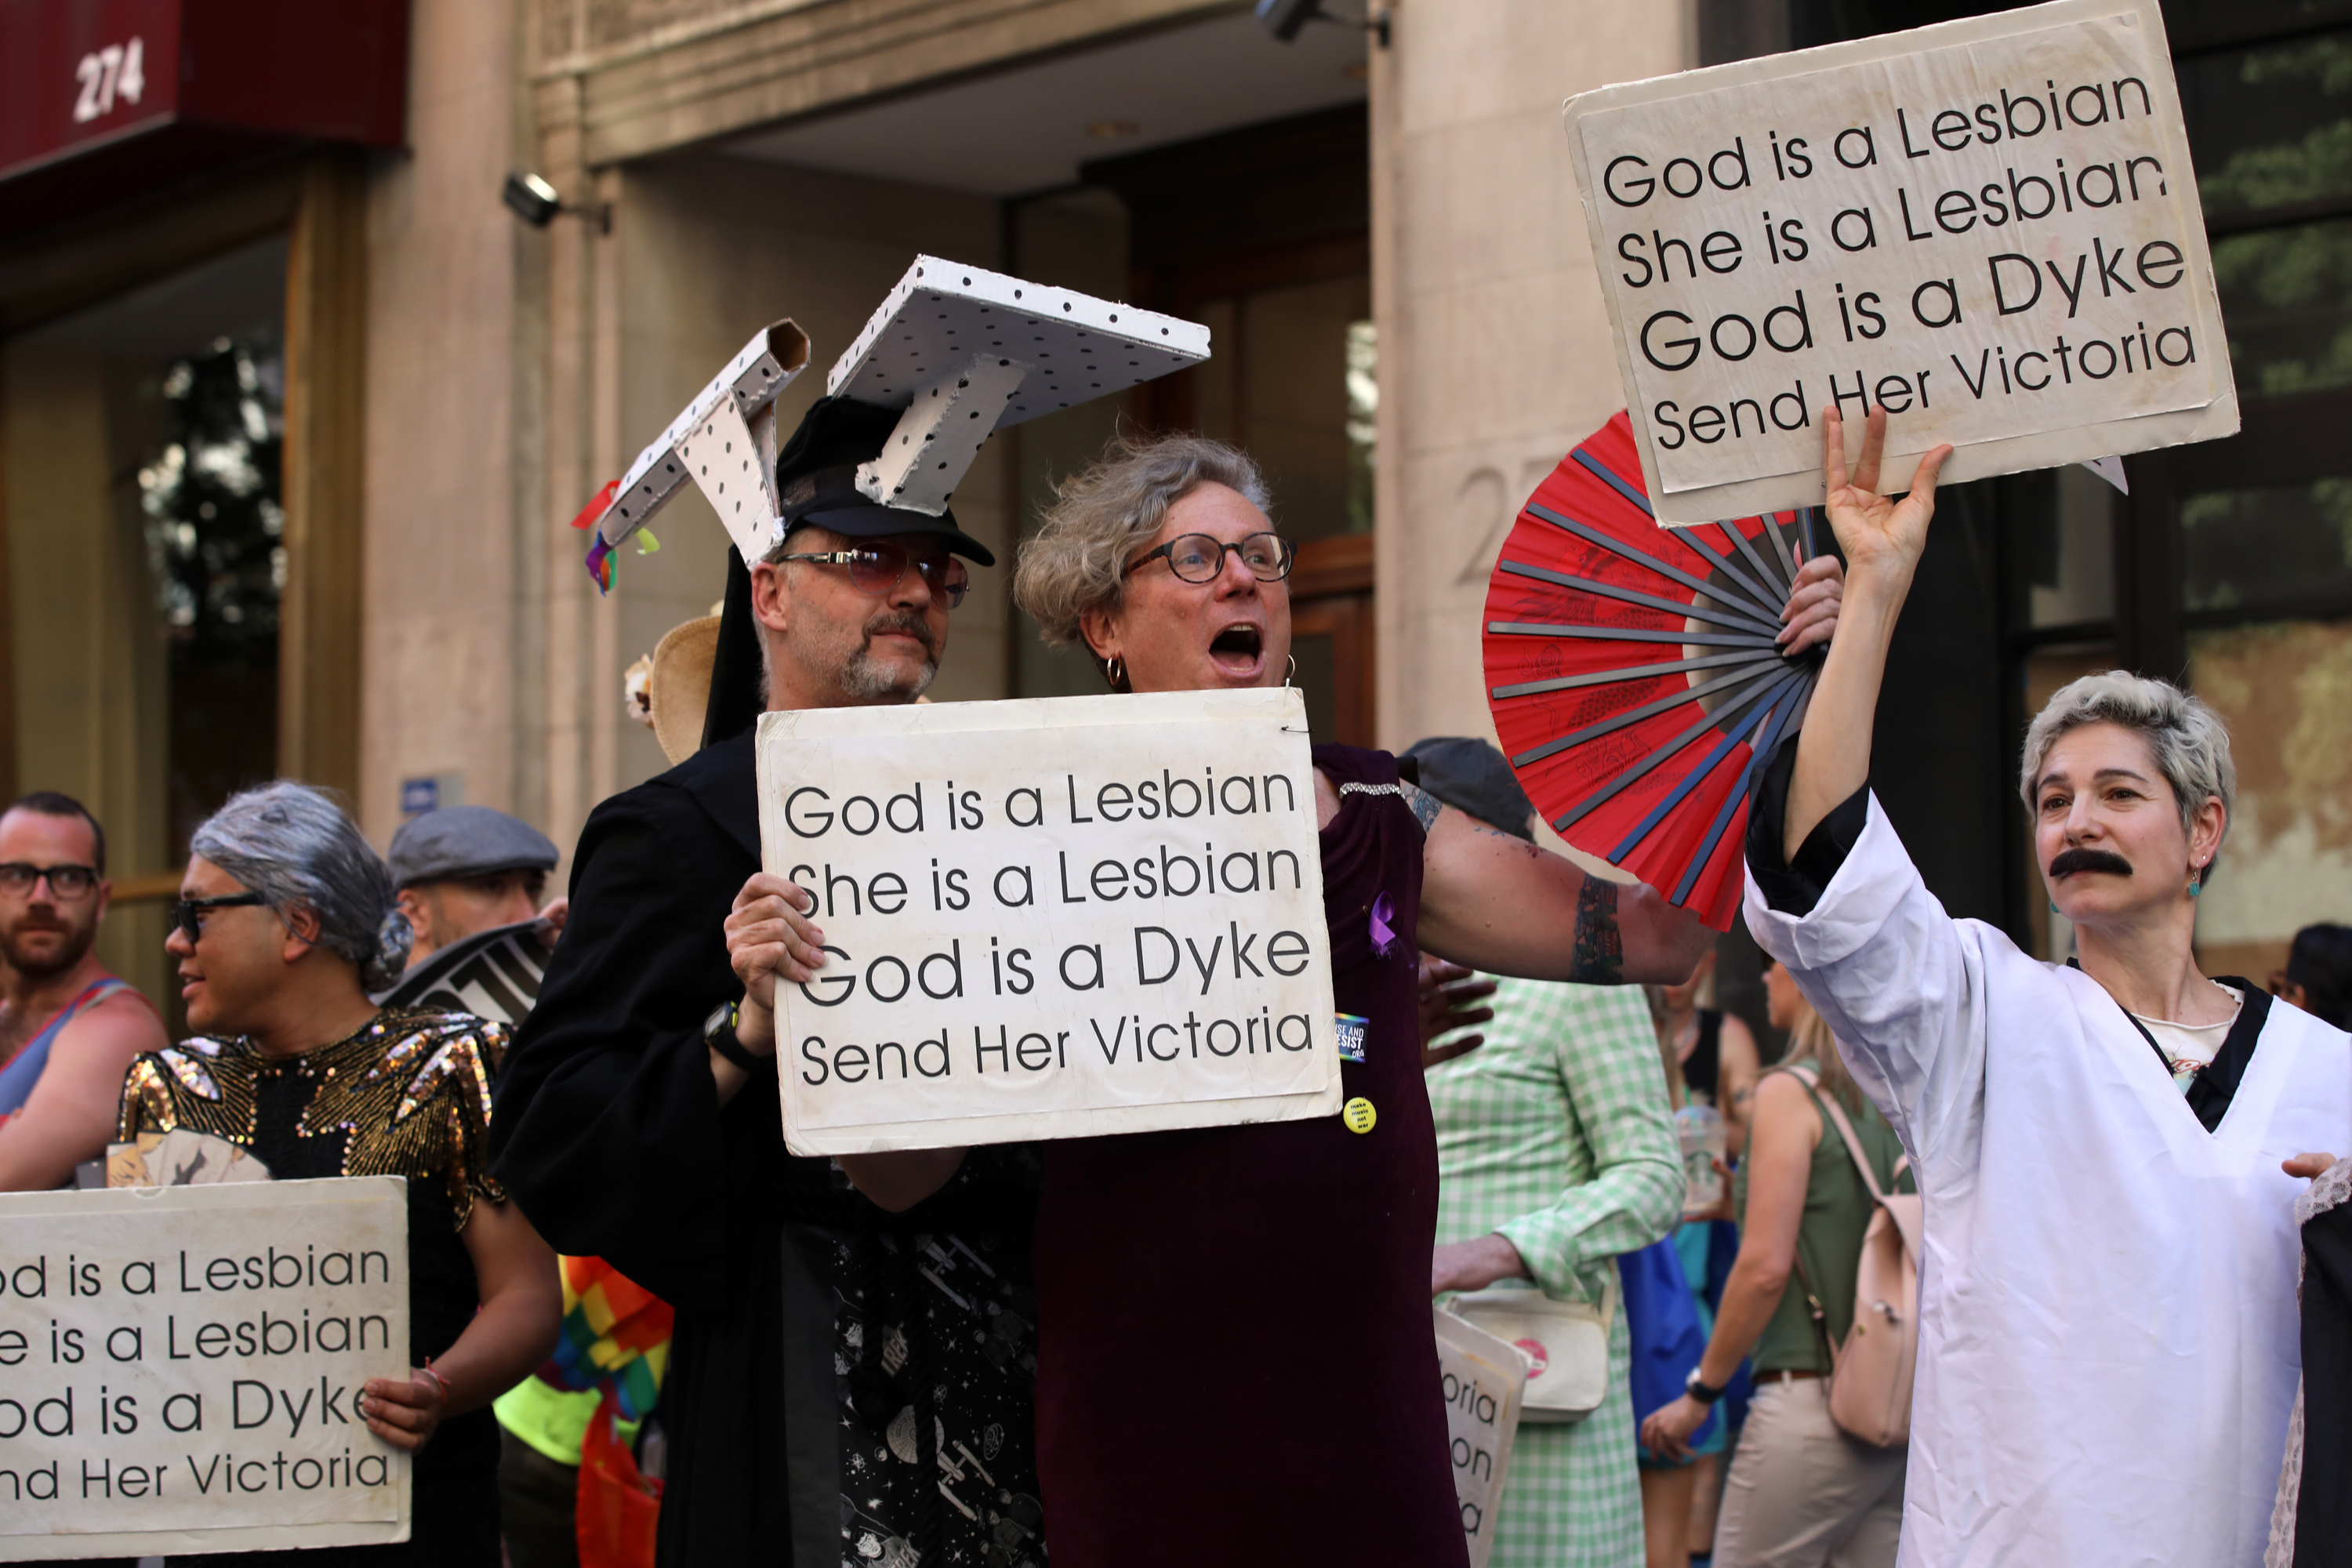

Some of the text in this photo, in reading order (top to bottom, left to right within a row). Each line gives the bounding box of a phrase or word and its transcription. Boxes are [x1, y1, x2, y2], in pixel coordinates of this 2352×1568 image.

[72, 35, 145, 124] 274
[1603, 76, 2152, 208] God is a Lesbian
[1617, 154, 2167, 289] She is a Lesbian
[1639, 237, 2185, 372] God is a Dyke
[1654, 321, 2197, 450] Send Her Victoria
[785, 766, 1295, 839] God is a Lesbian
[788, 841, 1301, 920] She is a Lesbian
[799, 920, 1310, 1007] God is a Dyke
[801, 1006, 1313, 1086] Send Her Victoria
[1348, 1025, 1364, 1039] AND
[70, 1254, 101, 1297] is
[122, 1261, 157, 1295] a
[180, 1243, 390, 1294] Lesbian
[51, 1319, 85, 1364] is
[106, 1326, 143, 1363] a
[169, 1308, 389, 1359] Lesbian
[101, 1385, 138, 1435] is
[162, 1392, 202, 1432] a
[1440, 1360, 1497, 1426] oria
[82, 1457, 168, 1499] Her
[187, 1447, 389, 1495] Victoria
